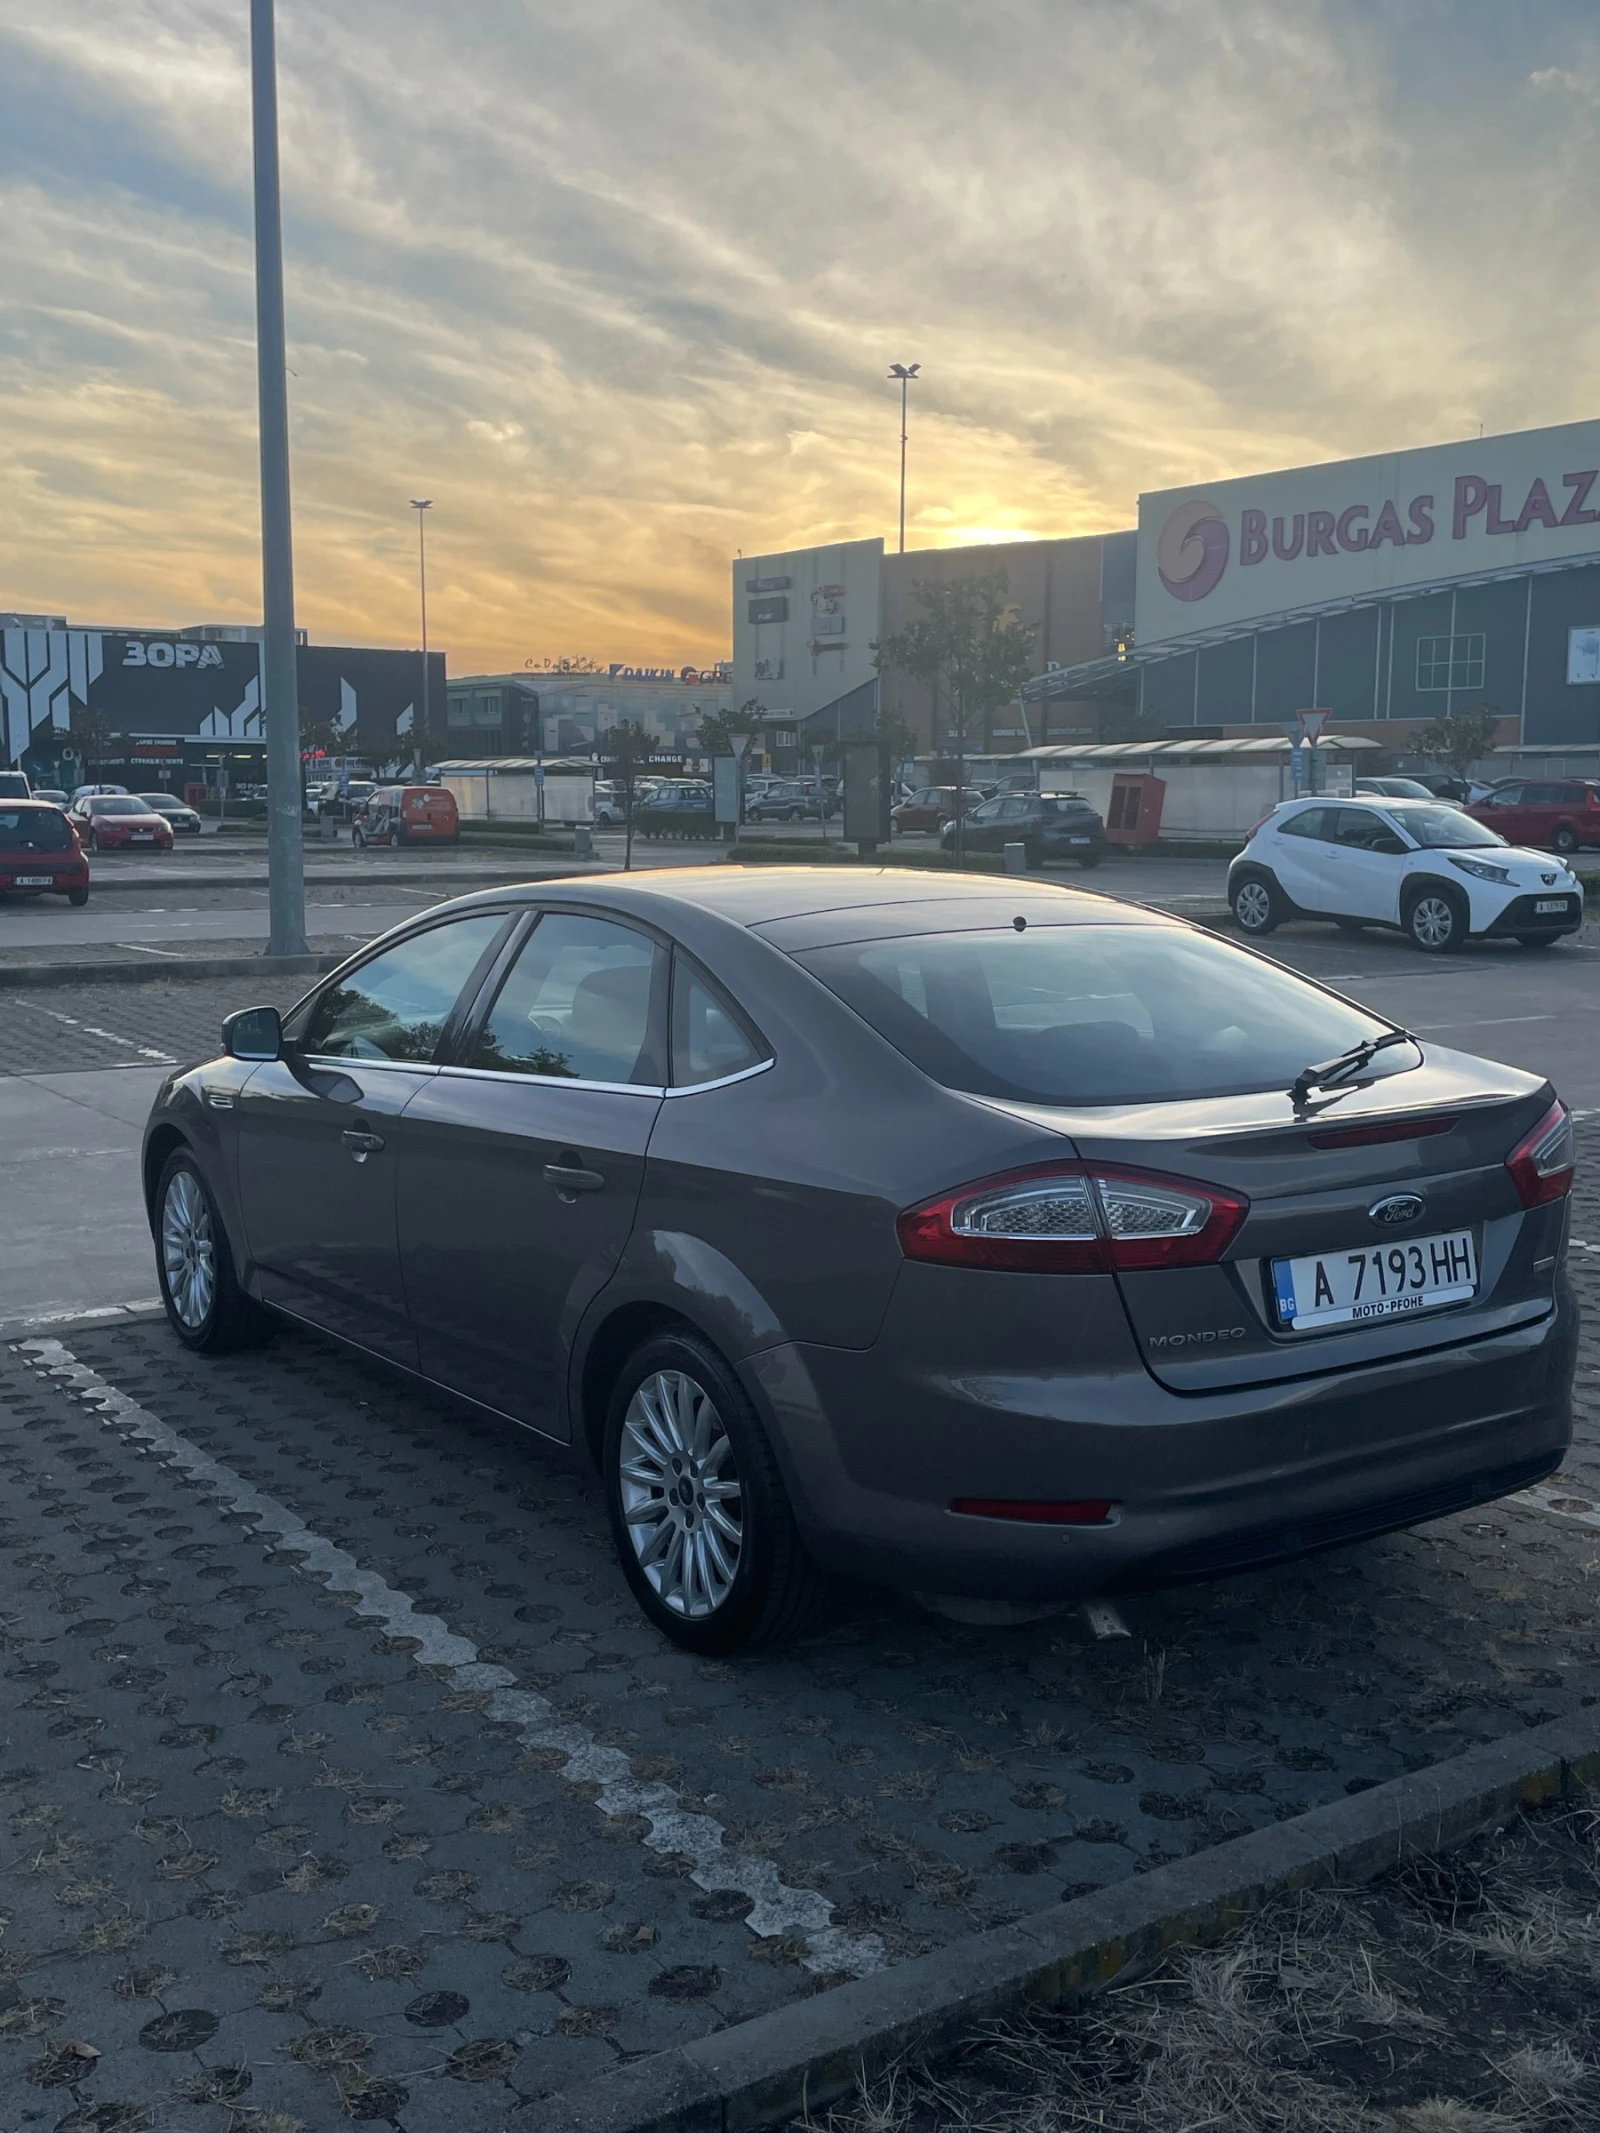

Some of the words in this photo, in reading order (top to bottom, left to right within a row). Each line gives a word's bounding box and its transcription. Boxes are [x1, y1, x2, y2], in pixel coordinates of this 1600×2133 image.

[1239, 495, 1435, 566] BURGAS
[1452, 470, 1600, 540] PLAZ
[122, 641, 225, 669] ЗОРА
[622, 667, 676, 682] DAIKIN
[648, 755, 683, 763] CHANGE
[1384, 1201, 1416, 1222] Ford
[1314, 1260, 1335, 1307] A
[1279, 1297, 1296, 1313] BG
[1352, 1295, 1424, 1319] MOTO-PFOHE
[1149, 1327, 1246, 1347] MONDEO
